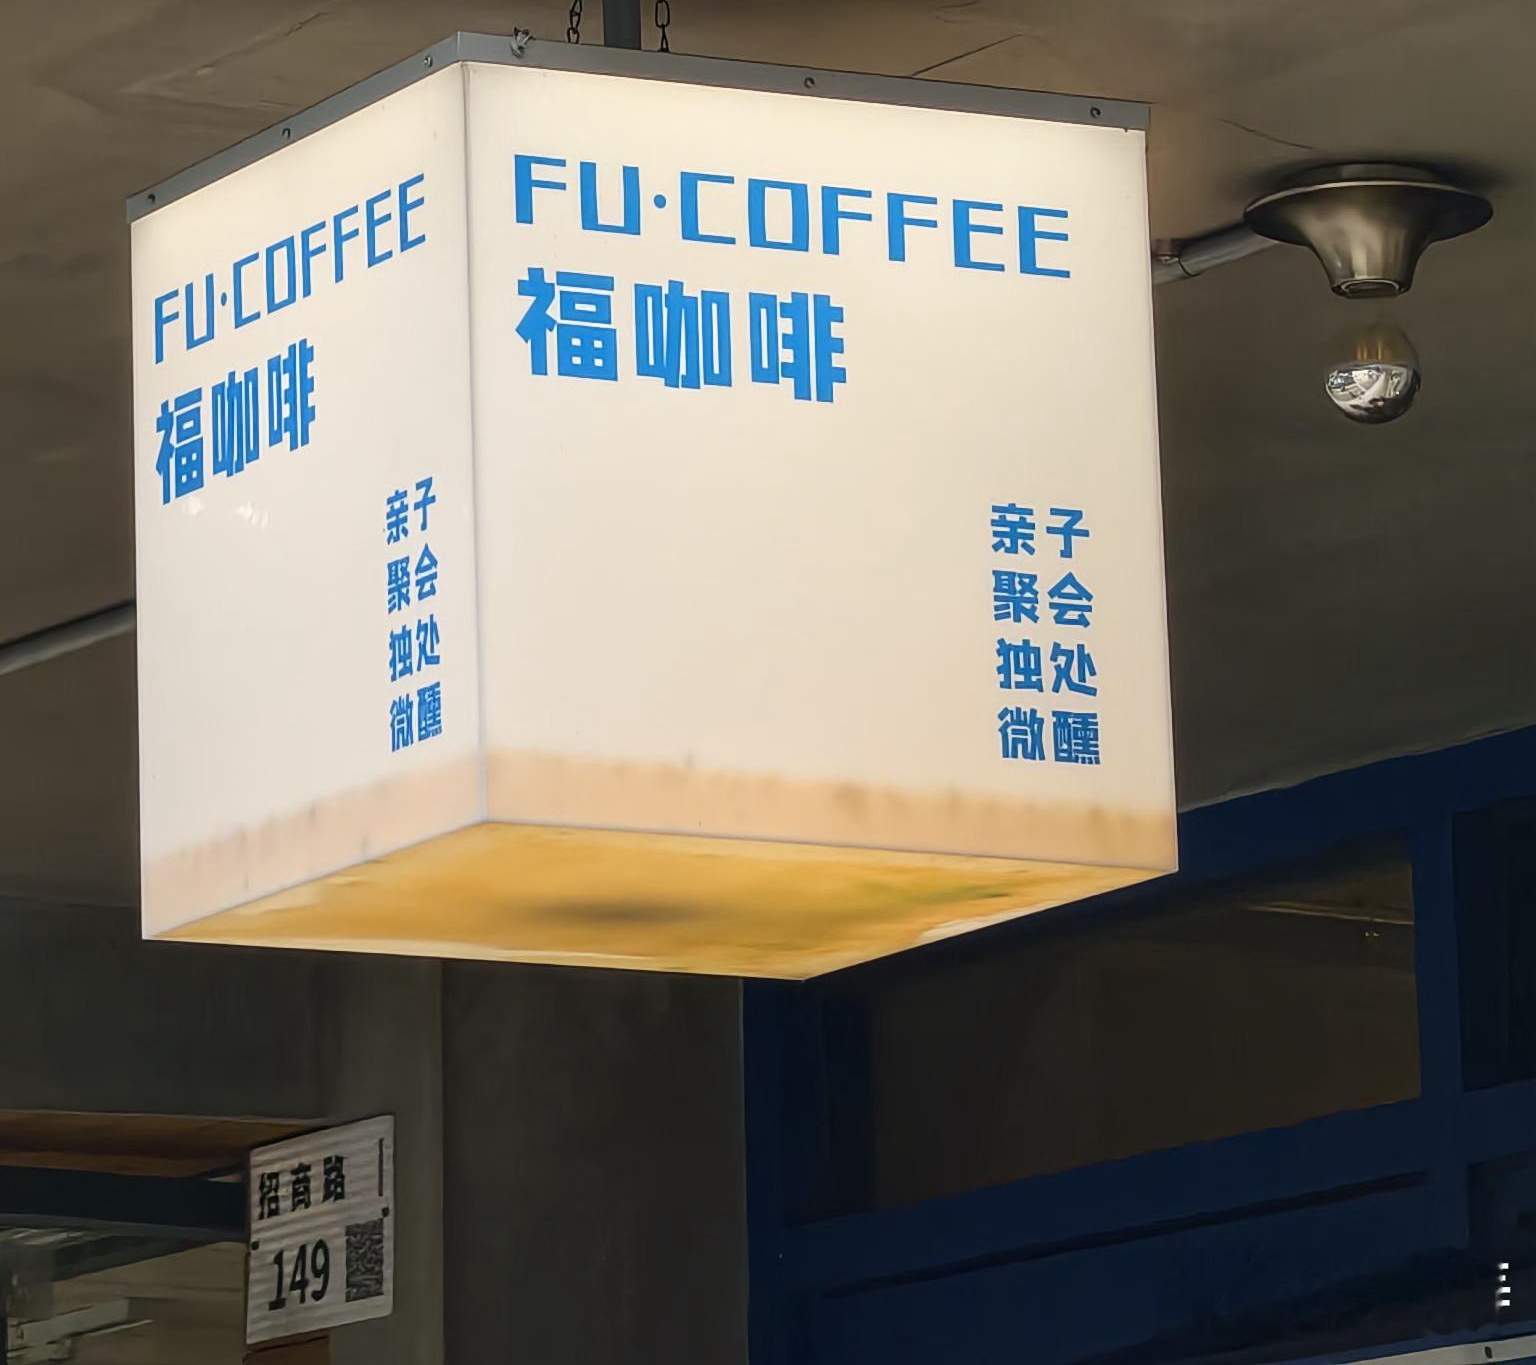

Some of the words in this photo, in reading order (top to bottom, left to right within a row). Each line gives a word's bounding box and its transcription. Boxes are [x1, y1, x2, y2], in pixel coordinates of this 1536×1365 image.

[513, 154, 1071, 279] FU·COFFEE
[154, 174, 426, 364] FU·COFFEE
[515, 266, 848, 404] 福咖啡
[155, 338, 317, 505] 福咖啡
[386, 476, 437, 545] 亲子
[990, 503, 1090, 559] 亲子
[387, 543, 439, 613] 聚会
[992, 570, 1094, 628] 聚会
[388, 614, 441, 682] 独处
[996, 638, 1098, 697] 独处
[390, 681, 443, 752] 微醺
[997, 706, 1101, 765] 微醺
[268, 1238, 330, 1310] 149
